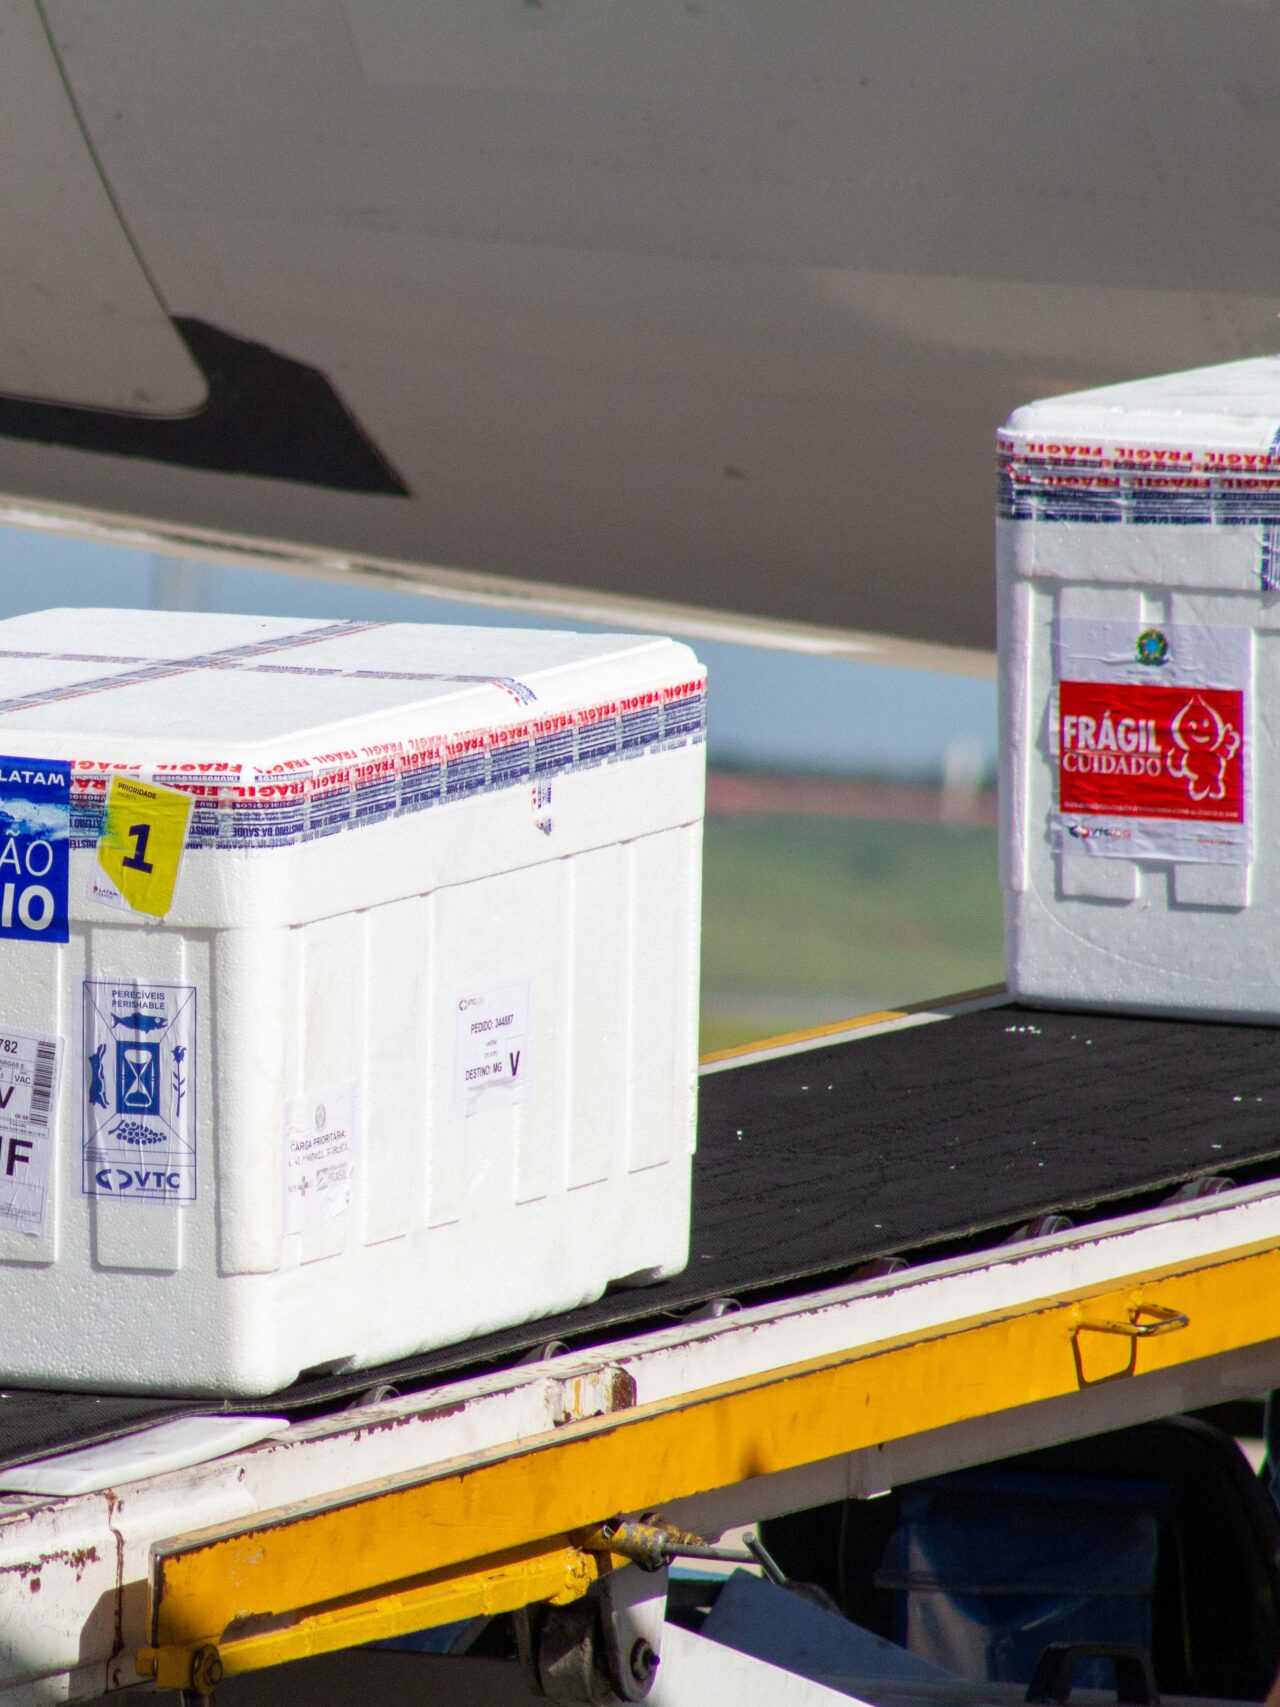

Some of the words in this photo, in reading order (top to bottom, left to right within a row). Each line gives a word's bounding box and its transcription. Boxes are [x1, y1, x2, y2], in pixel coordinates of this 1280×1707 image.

[1063, 709, 1161, 753] FRÁGIL
[1063, 753, 1161, 776] CUIDADO
[118, 782, 157, 799] PRIORIDADE
[122, 823, 153, 874] 1
[111, 989, 165, 1000] PERECÍVEIS
[111, 1000, 165, 1009] PERISHABLE
[471, 1020, 494, 1034] PEDIDO:
[493, 1062, 503, 1074] MG
[509, 1050, 520, 1076] V
[14, 1075, 31, 1085] VAC
[134, 1170, 180, 1189] VTC
